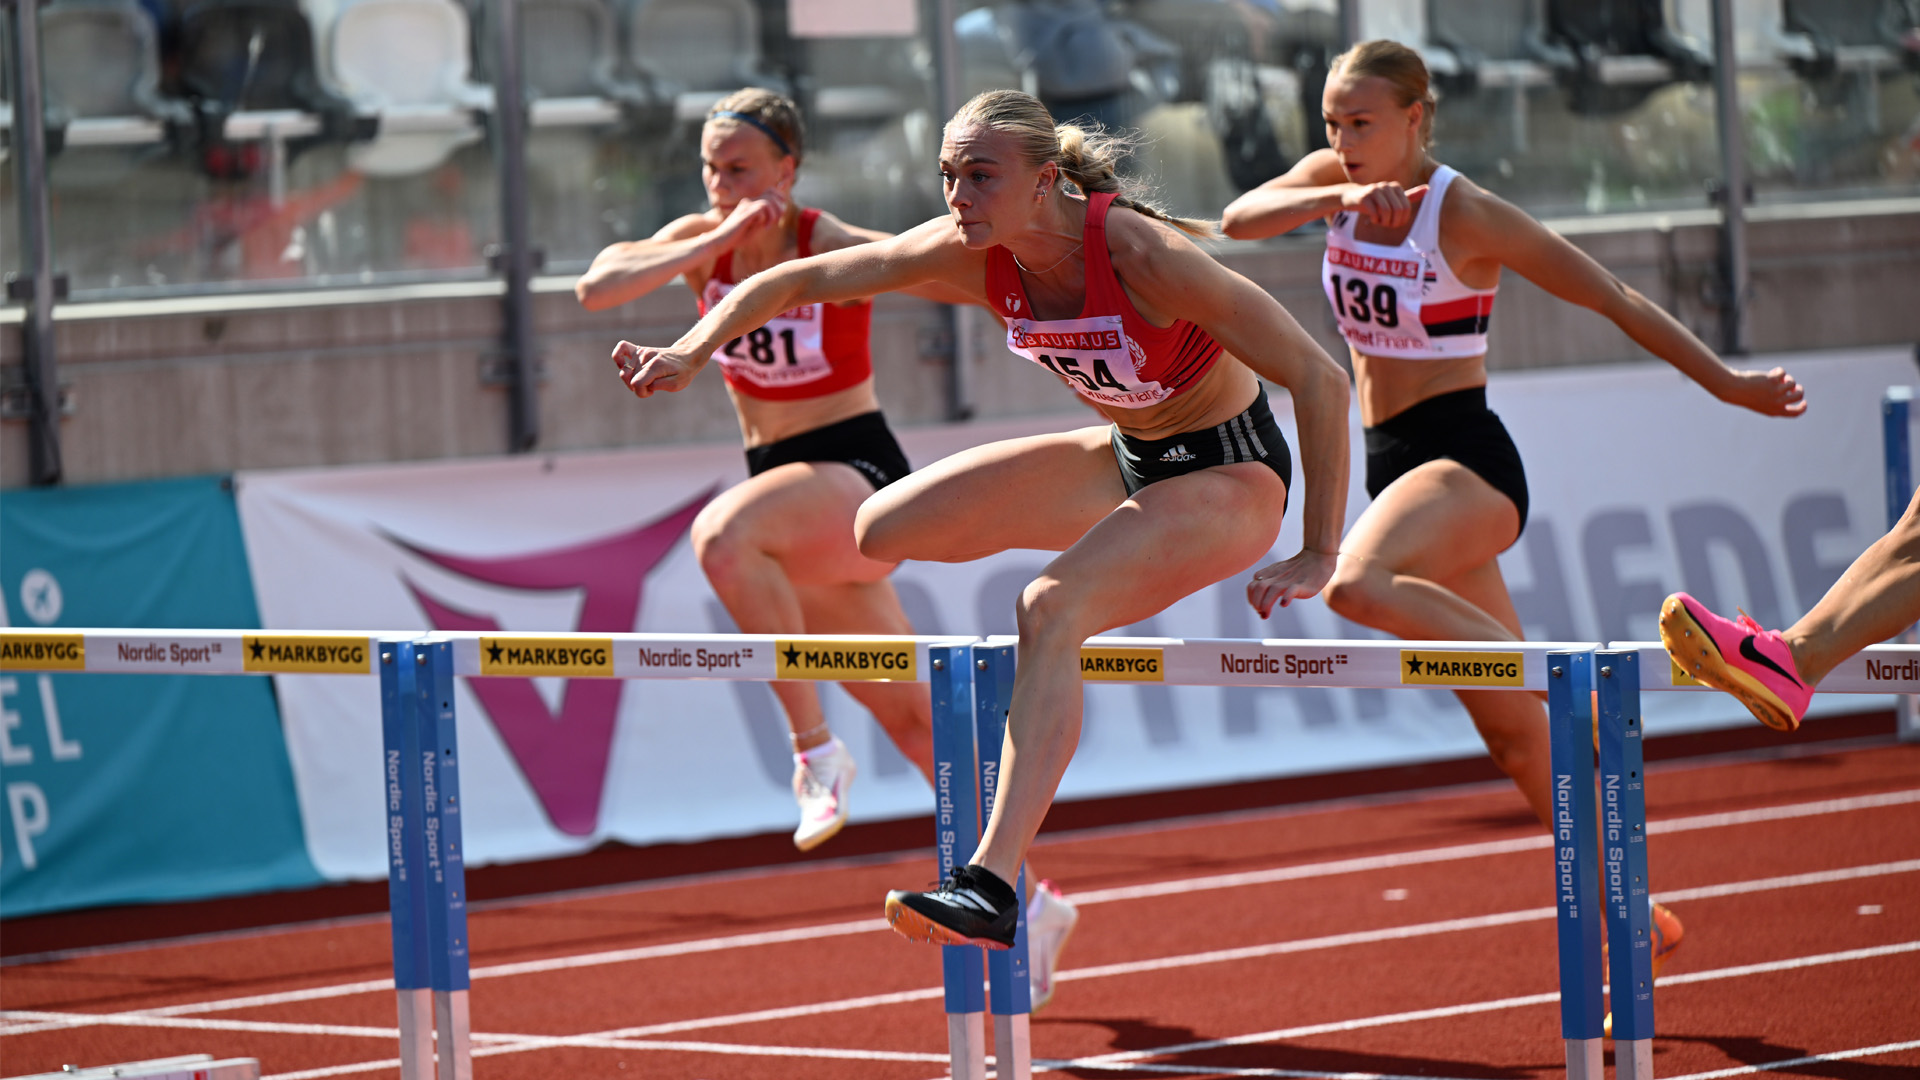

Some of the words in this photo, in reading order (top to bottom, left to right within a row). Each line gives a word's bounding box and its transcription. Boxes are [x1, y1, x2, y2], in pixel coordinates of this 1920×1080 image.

[1329, 248, 1417, 278] BAUHAUS
[1331, 274, 1399, 328] 139
[723, 326, 798, 366] 281
[1025, 331, 1118, 348] BAUHAUS
[1038, 354, 1131, 392] 154
[118, 643, 166, 662] Nordic
[170, 643, 210, 666] Sport
[269, 644, 363, 664] MARKBYGG
[507, 646, 607, 667] MARKBYGG
[638, 647, 691, 667] Nordic
[697, 648, 741, 672] Sport
[805, 651, 909, 670] MARKBYGG
[1080, 657, 1158, 673] ARKBYGG
[1221, 653, 1279, 674] Nordic
[1285, 654, 1335, 678] Sport
[1426, 659, 1518, 678] MARKBYGG
[1866, 659, 1920, 681] Nordi
[387, 750, 403, 811] Nordic
[423, 751, 439, 813] Nordic
[938, 761, 954, 826] Nordic
[1557, 774, 1574, 841] Nordic
[1605, 774, 1624, 842] Nordic
[390, 816, 405, 867] Sport
[425, 818, 441, 869] Sport
[1558, 846, 1576, 903] Sport
[1607, 847, 1625, 903] Sport
